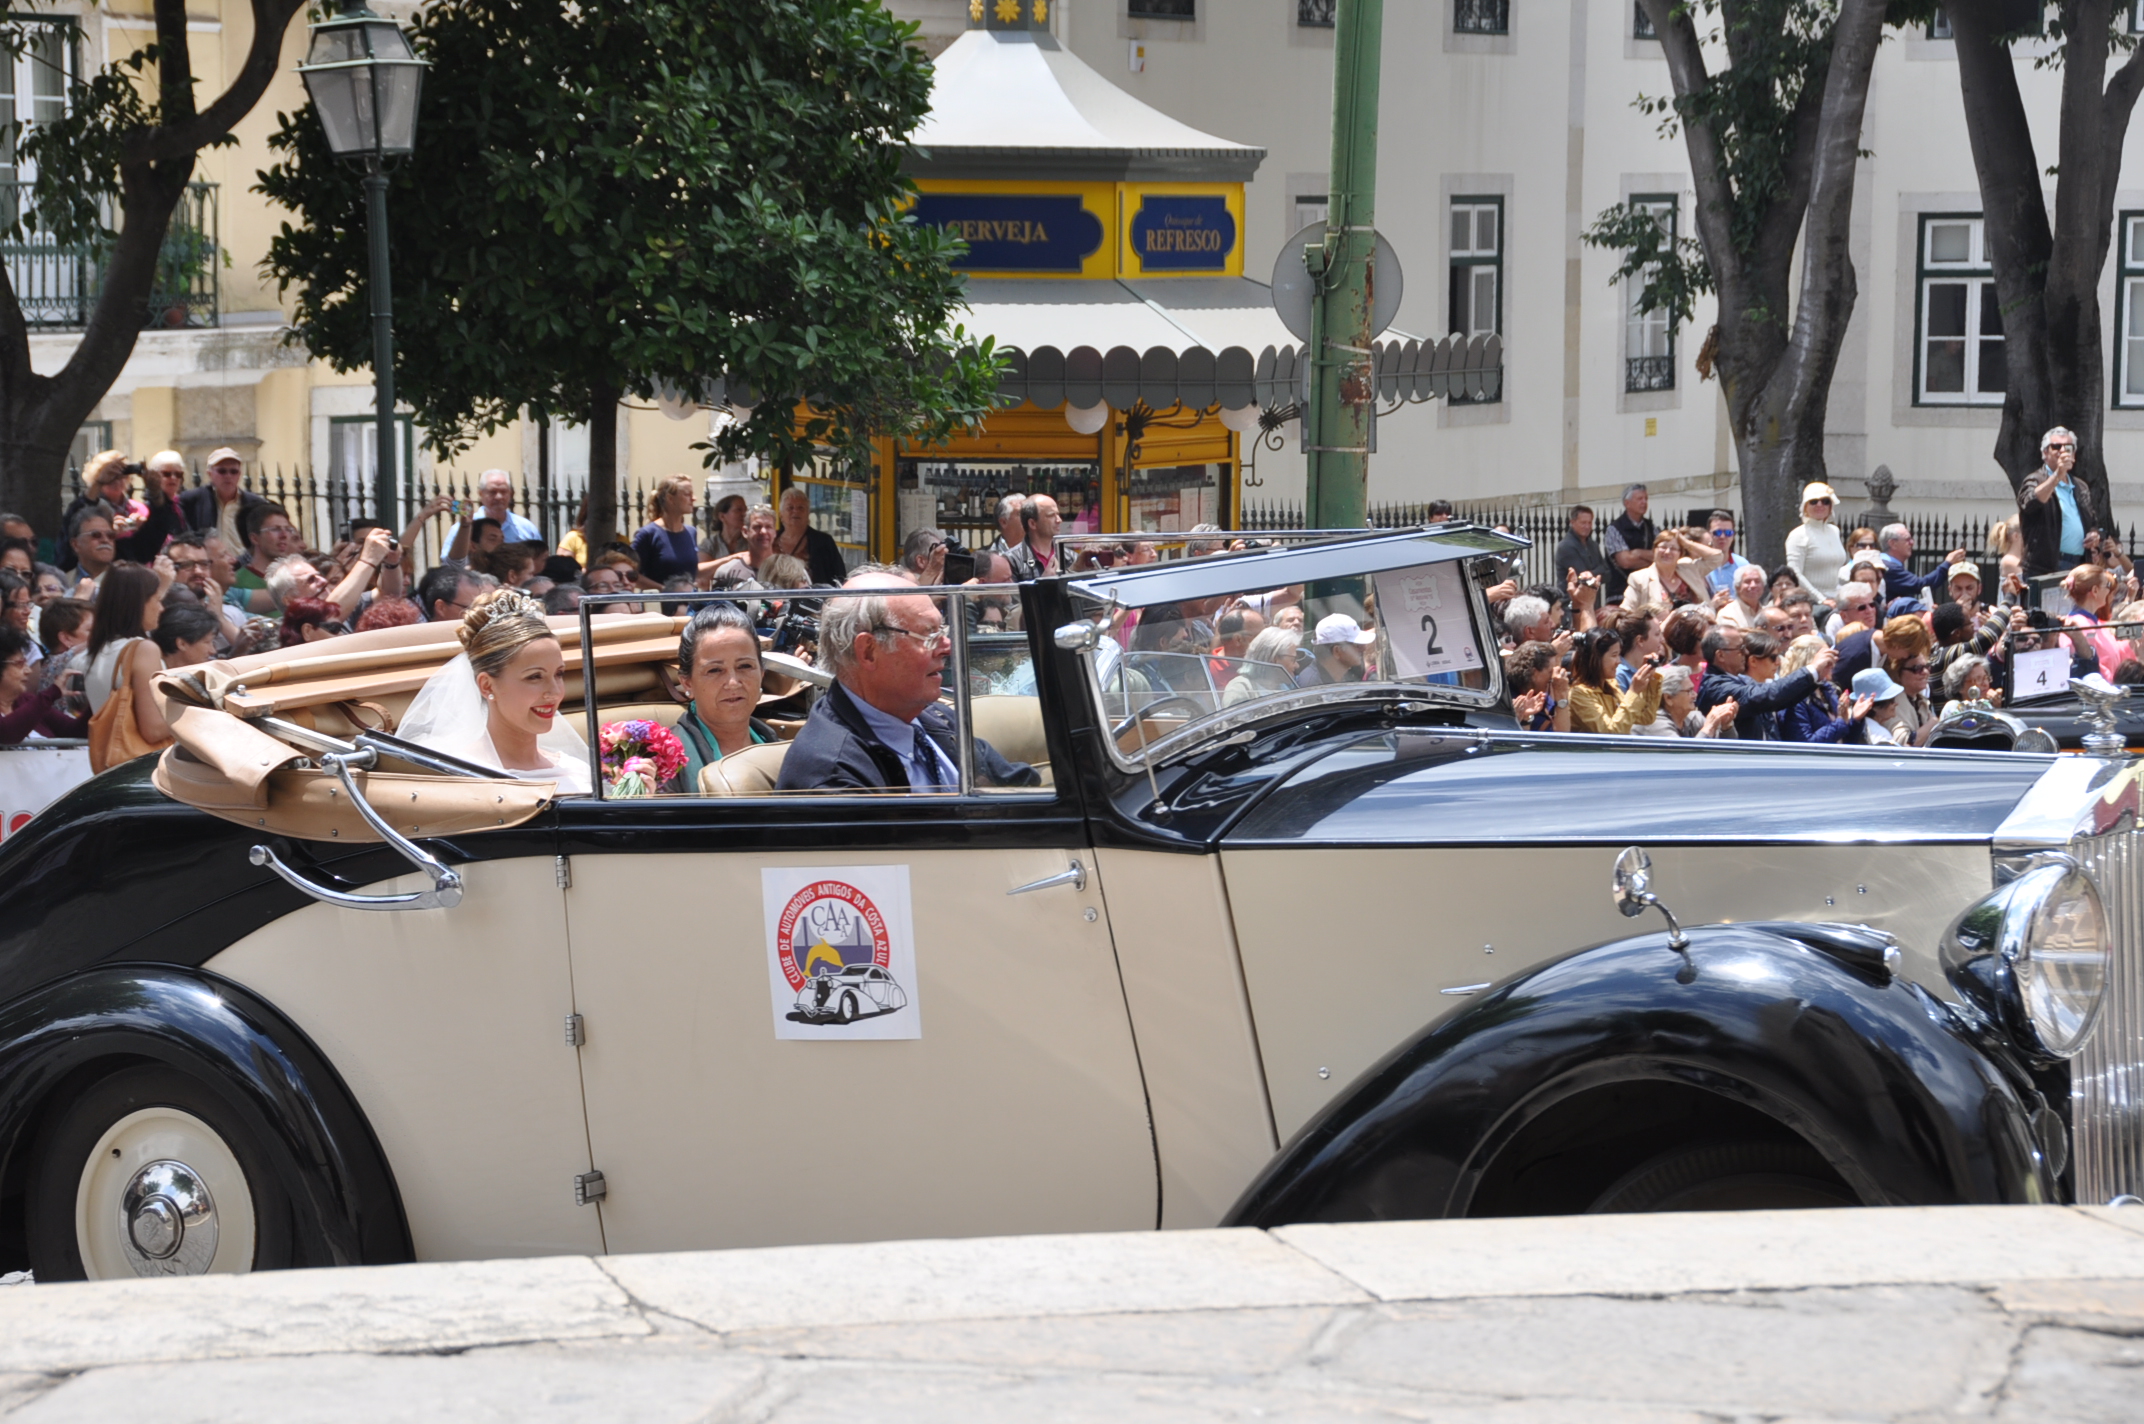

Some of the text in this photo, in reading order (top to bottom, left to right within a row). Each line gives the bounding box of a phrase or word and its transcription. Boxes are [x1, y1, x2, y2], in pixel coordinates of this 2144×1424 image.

[1146, 229, 1221, 251] REFRESCO
[1421, 614, 1443, 655] 2
[2036, 670, 2047, 686] 4
[779, 883, 888, 984] CLUBE DE AUTOMÓVEIS ANTIGOS DA COSTA AZUL
